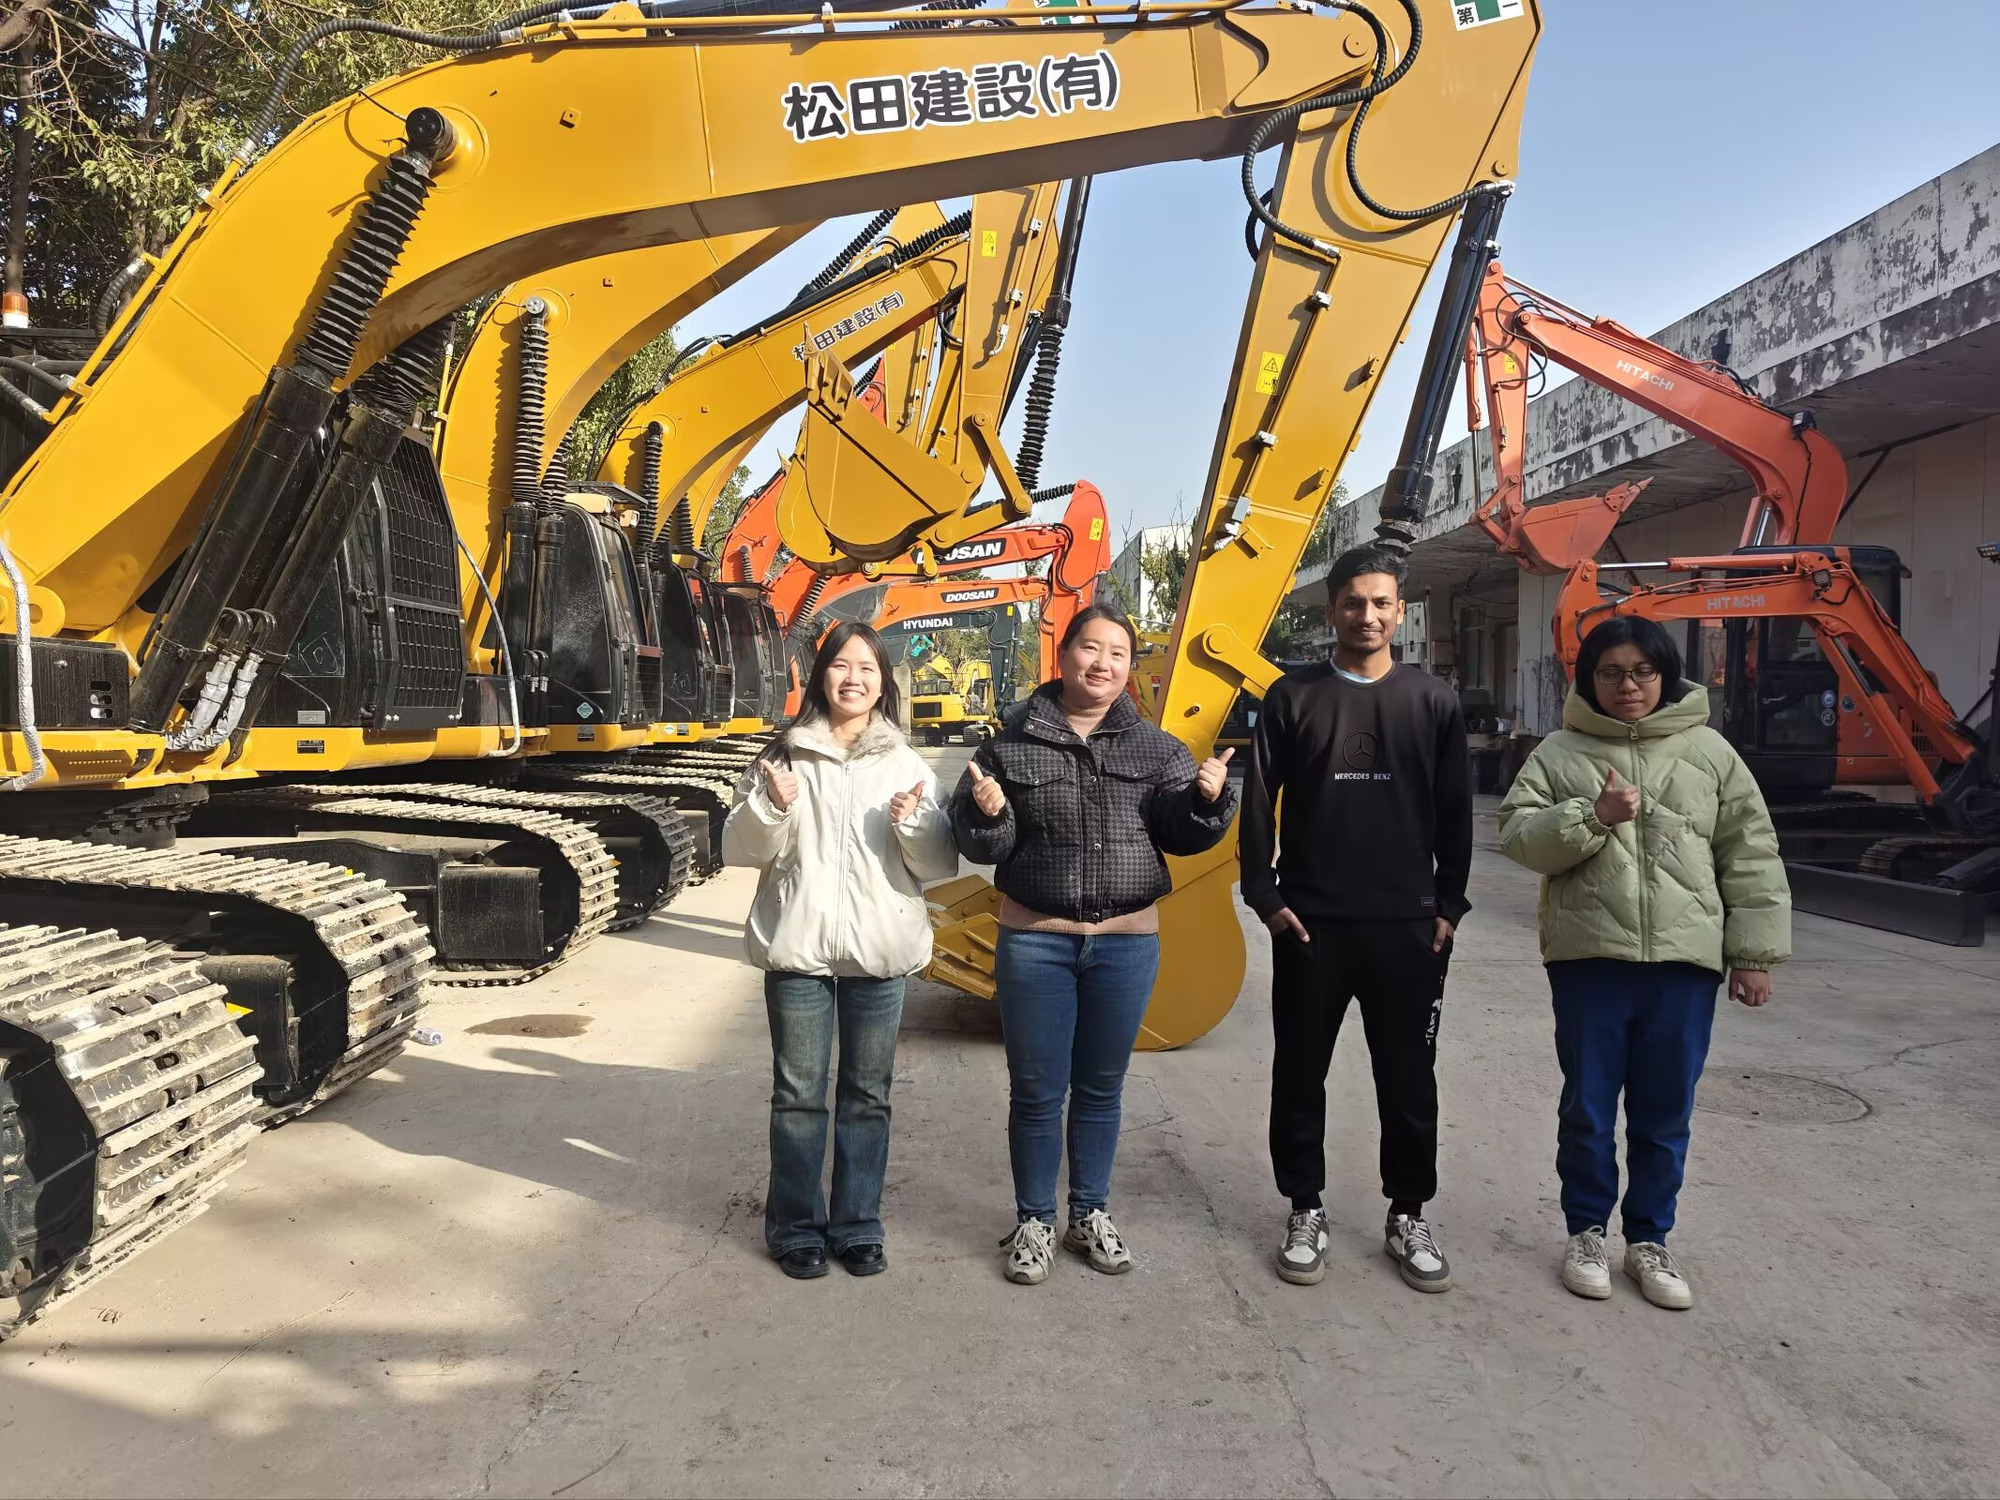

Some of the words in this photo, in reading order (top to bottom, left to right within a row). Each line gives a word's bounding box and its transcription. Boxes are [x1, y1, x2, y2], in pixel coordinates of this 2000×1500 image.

[784, 51, 1118, 140] 松田建設(有)
[1616, 359, 1675, 391] HITACHI
[945, 589, 995, 603] DOOSAN
[1706, 593, 1765, 611] HITACHI
[903, 617, 953, 630] HYUNDAI
[1334, 772, 1370, 780] MERCEDES
